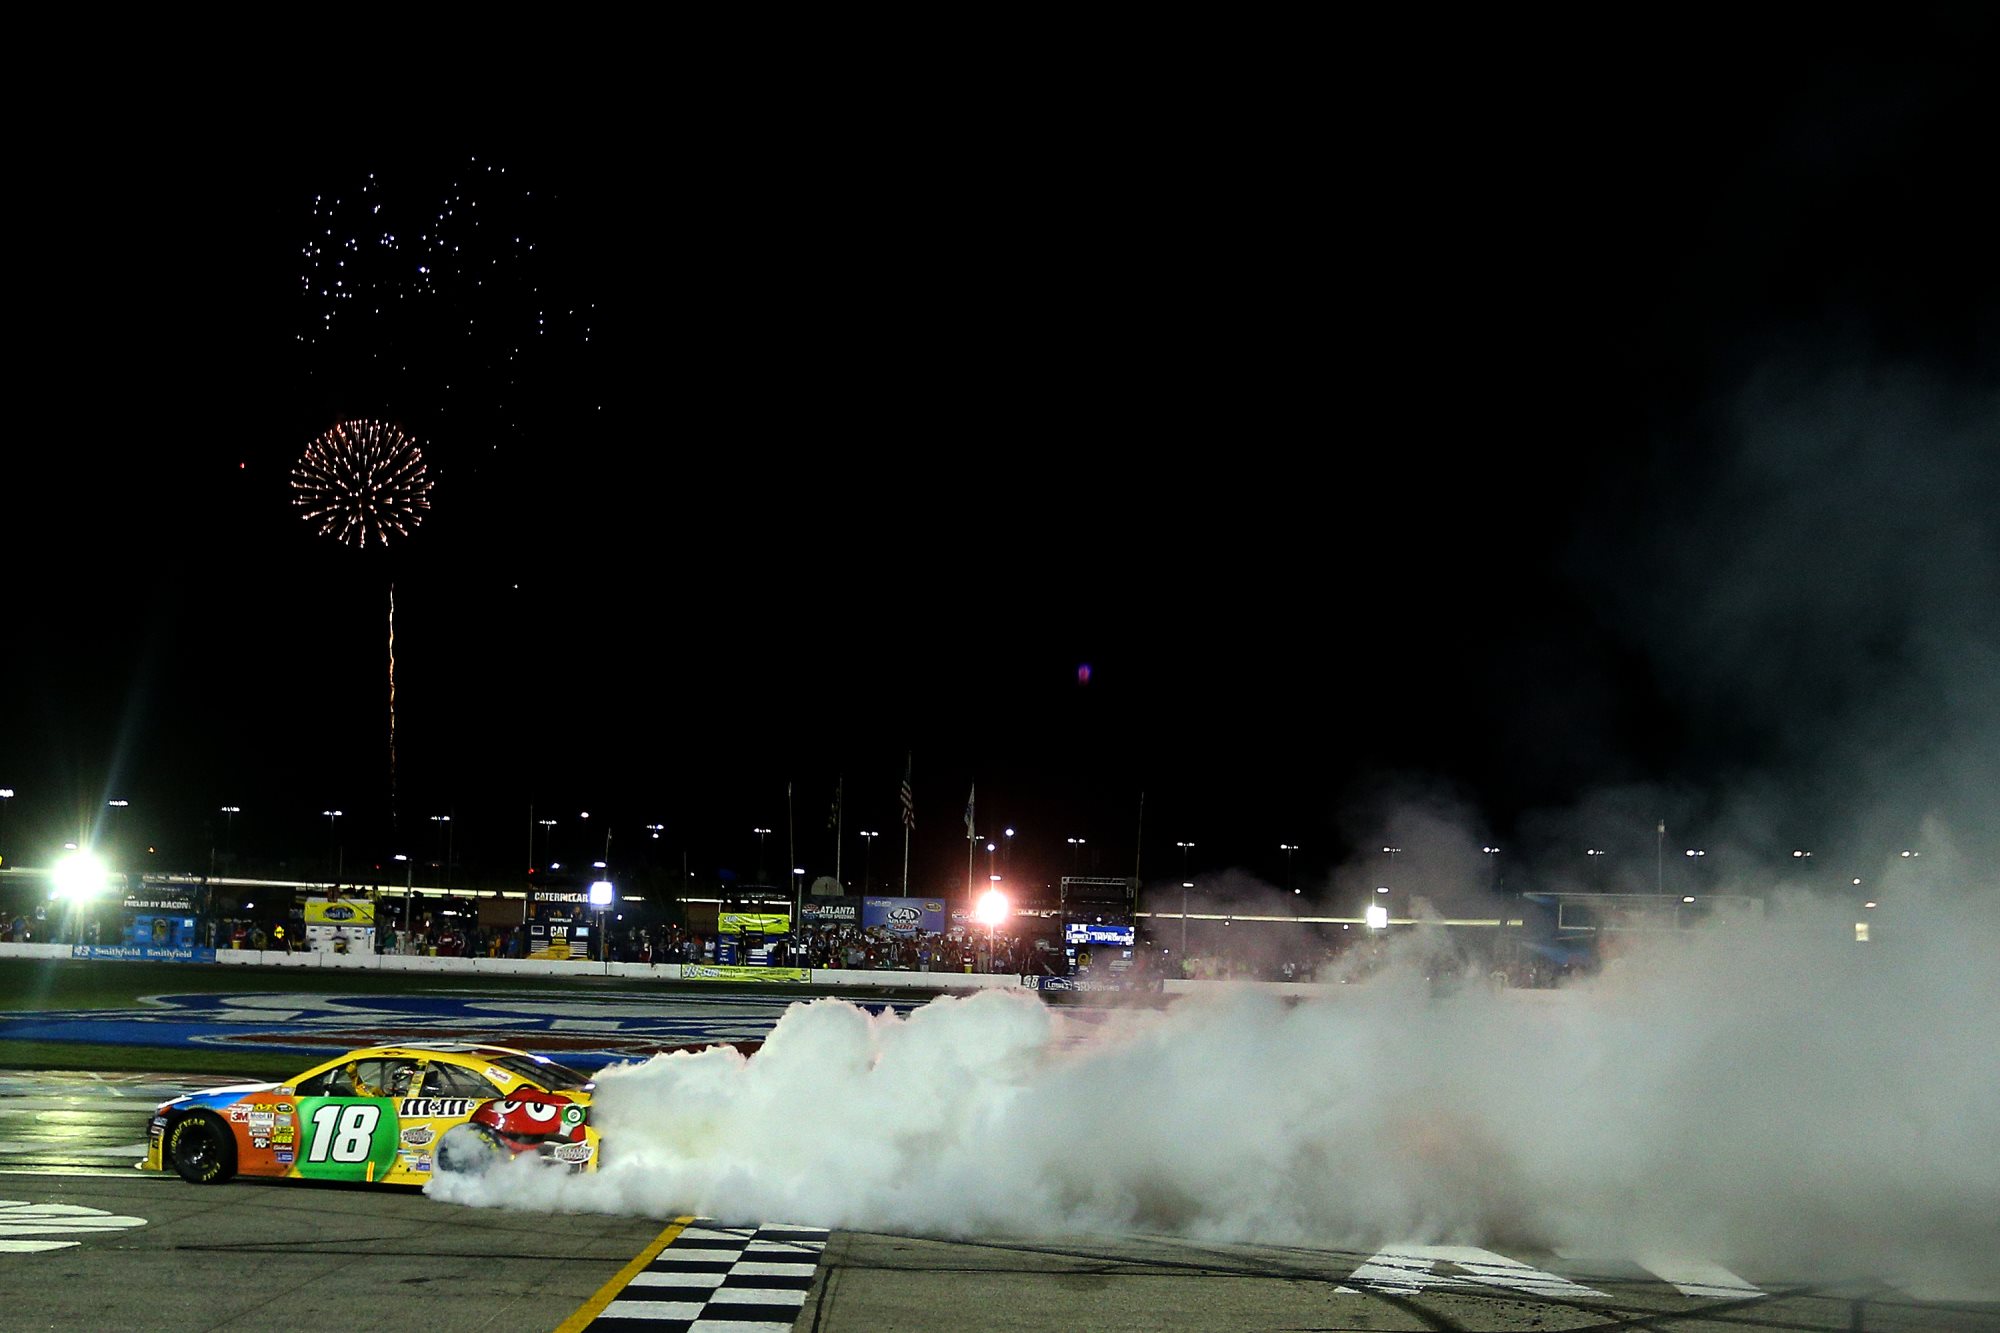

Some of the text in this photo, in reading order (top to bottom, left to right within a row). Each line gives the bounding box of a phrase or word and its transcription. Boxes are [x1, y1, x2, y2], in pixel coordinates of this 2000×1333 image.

[534, 892, 588, 902] CATERPILLAR
[150, 900, 160, 908] BY
[820, 905, 856, 915] ATLANTA
[550, 926, 569, 937] CAT
[73, 945, 192, 959] 43 Smithfield Smithfield
[1023, 975, 1038, 989] 48
[231, 1110, 249, 1122] 3M
[171, 1118, 205, 1153] GOODYEAR
[307, 1104, 382, 1163] 18
